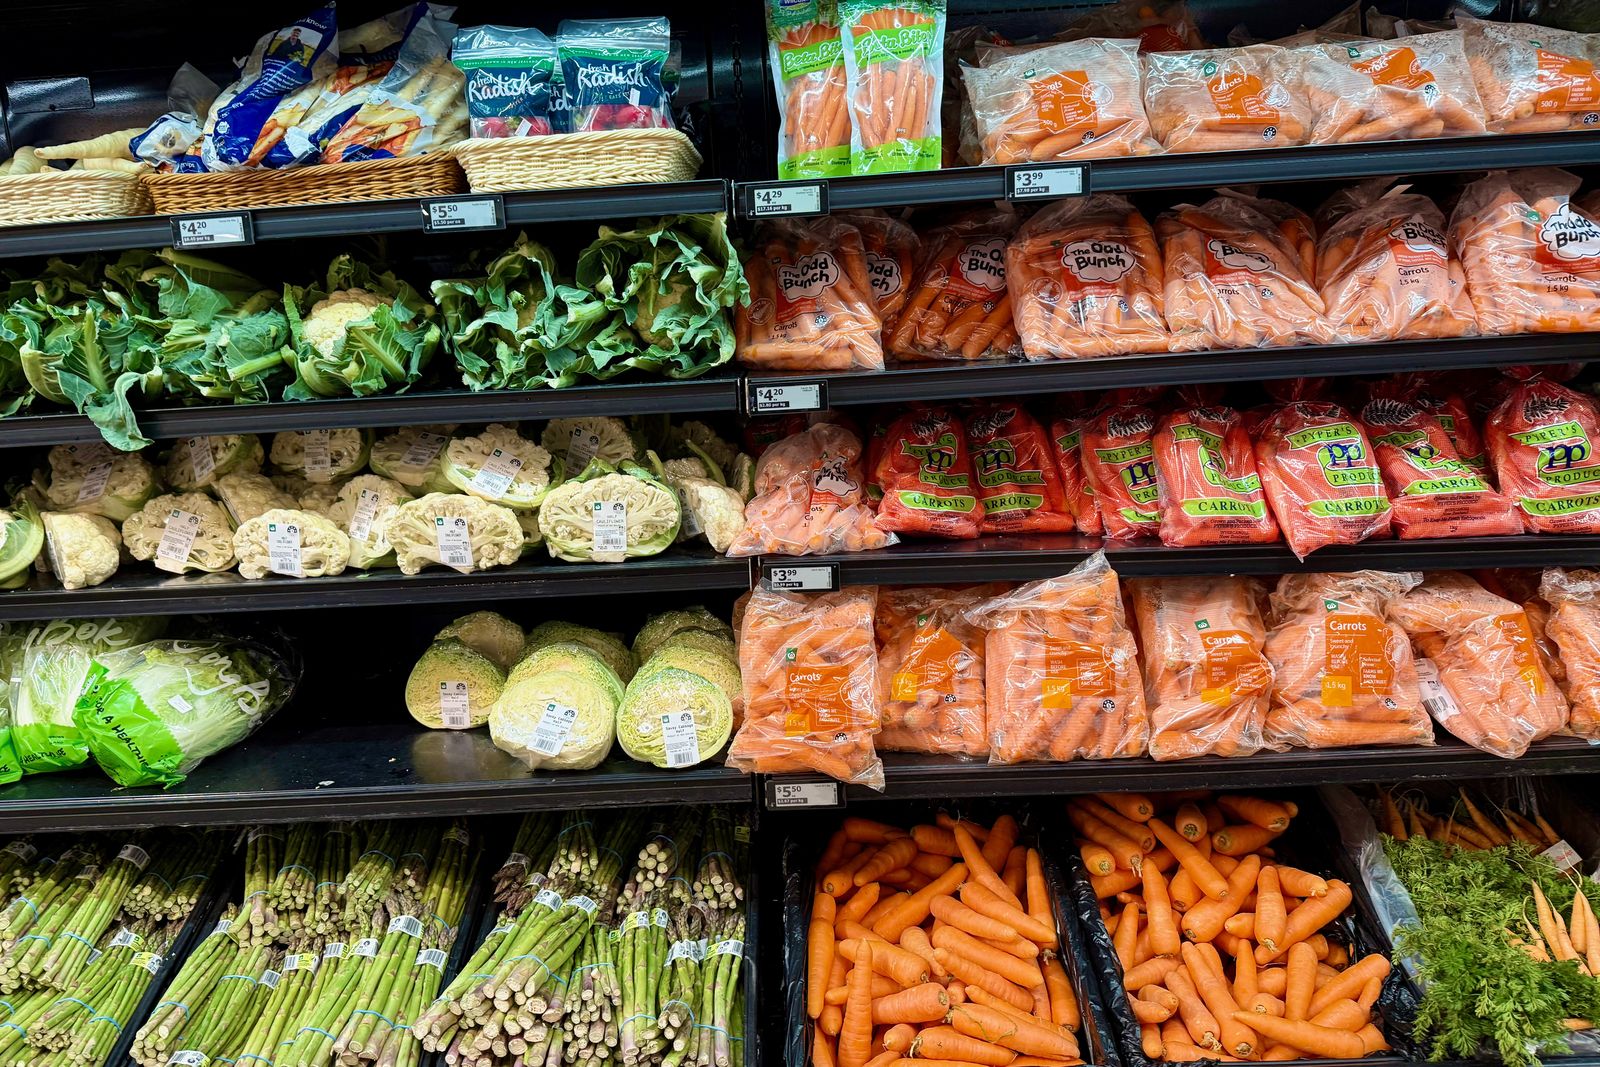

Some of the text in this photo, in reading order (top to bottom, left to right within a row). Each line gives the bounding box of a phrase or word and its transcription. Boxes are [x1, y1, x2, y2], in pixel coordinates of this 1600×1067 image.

[783, 50, 819, 73] Beta
[577, 62, 648, 90] Radish
[468, 71, 533, 103] Radish
[1212, 77, 1242, 93] Carrots
[970, 248, 988, 259] The
[1071, 247, 1091, 256] The
[782, 257, 829, 279] The Odd
[967, 258, 1005, 278] Bunc
[1075, 255, 1126, 271] Bunch
[1398, 266, 1430, 276] Carrots
[783, 269, 830, 291] Bunch
[1559, 283, 1569, 292] kg
[773, 321, 798, 332] Carrots
[1302, 425, 1352, 443] PYPER'S
[1525, 424, 1577, 442] PYPER'S
[1107, 444, 1151, 462] PYPER'S
[985, 471, 1033, 485] PRODUCE
[1546, 468, 1600, 484] PRODUC
[913, 495, 966, 508] CARROTS
[1324, 496, 1385, 513] CARROTS
[1535, 494, 1600, 513] CARROTS
[1329, 620, 1367, 631] Carrots
[789, 672, 821, 683] Carrots
[1337, 681, 1346, 690] kg
[102, 715, 114, 725] A
